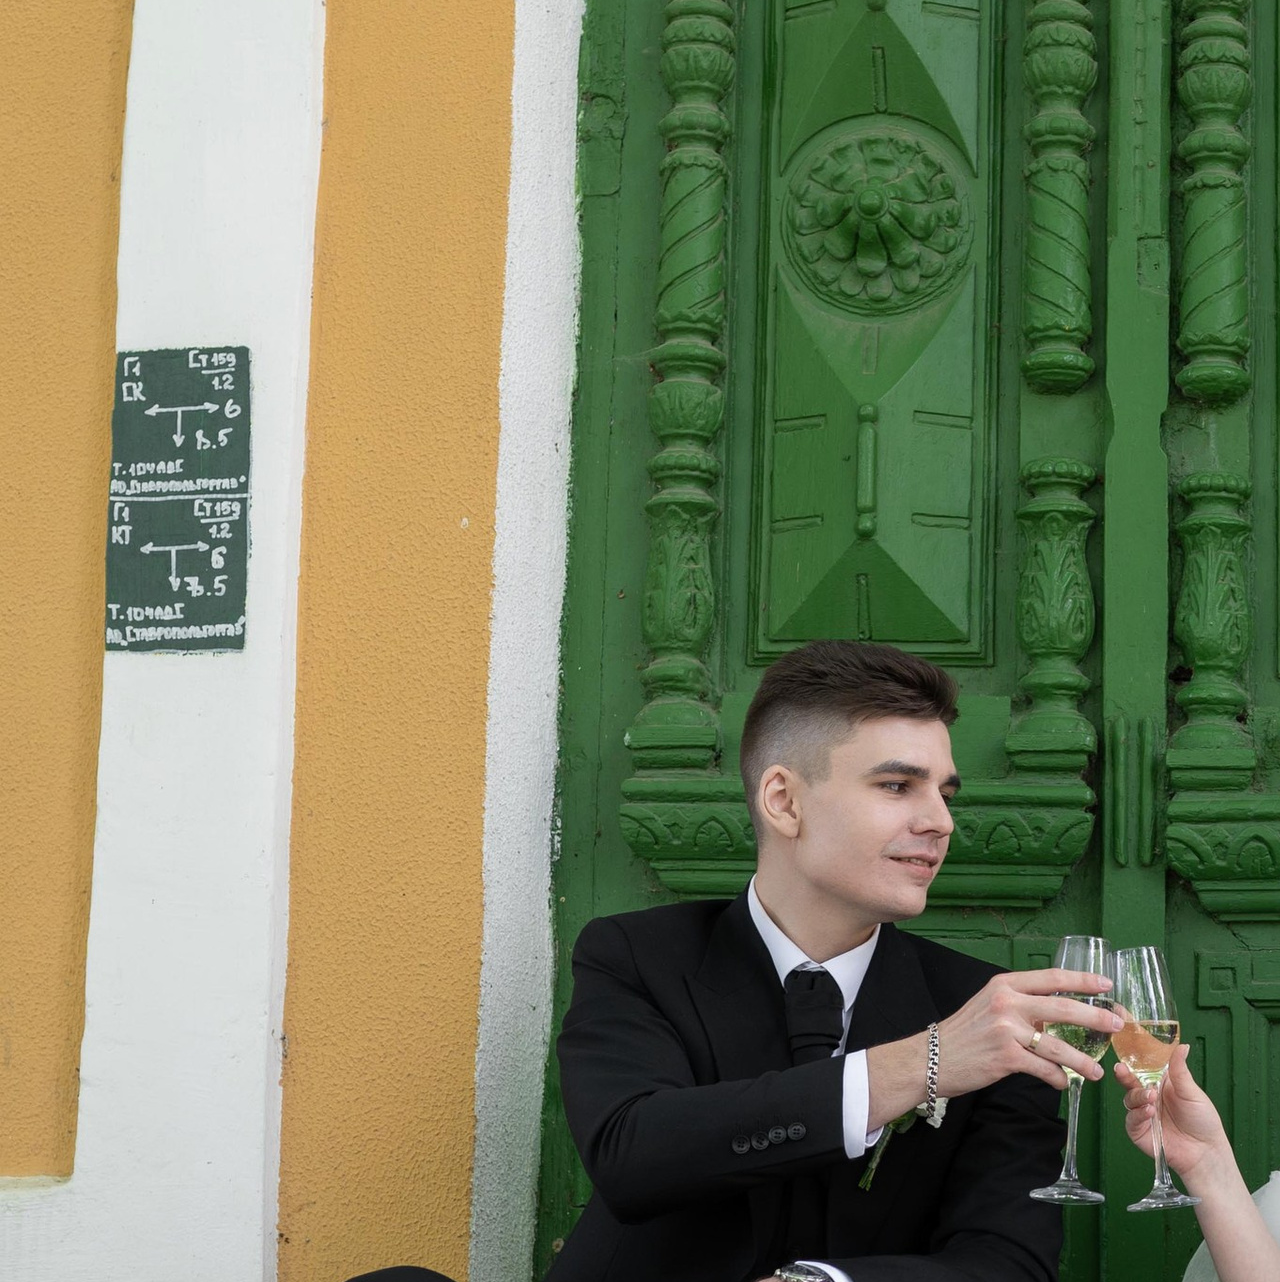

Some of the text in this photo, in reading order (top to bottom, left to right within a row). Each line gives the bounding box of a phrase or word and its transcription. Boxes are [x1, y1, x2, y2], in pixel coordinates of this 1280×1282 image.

[211, 353, 236, 367] 159
[212, 374, 235, 390] 1.2
[224, 398, 241, 418] 6
[214, 501, 241, 517] 159
[208, 522, 232, 538] 1.2
[211, 546, 227, 569] 6
